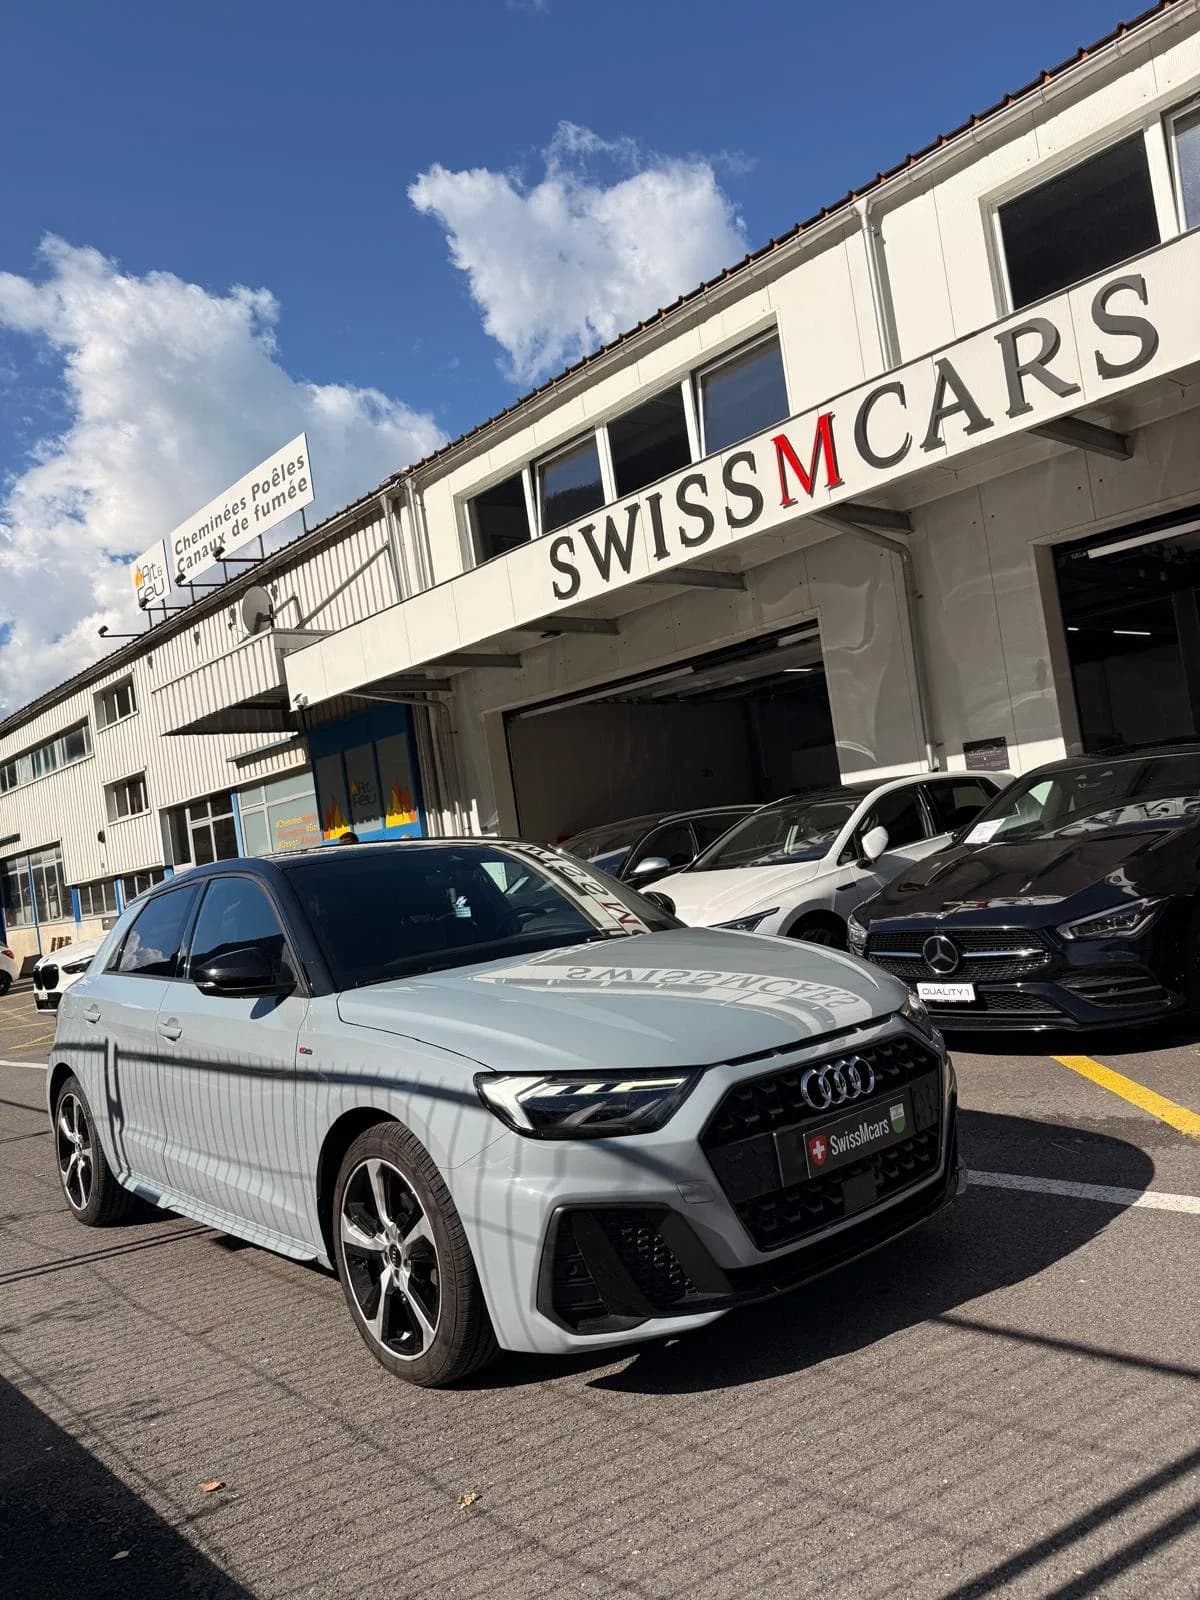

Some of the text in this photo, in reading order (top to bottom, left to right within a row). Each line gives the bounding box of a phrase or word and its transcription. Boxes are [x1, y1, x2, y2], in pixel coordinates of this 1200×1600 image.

[549, 274, 1160, 600] SWISSMCARS
[174, 455, 305, 556] Cheminées Poêles
[177, 476, 308, 574] Canaux de fumée
[922, 988, 963, 996] QUALITY
[829, 1119, 890, 1155] SwissMcars
